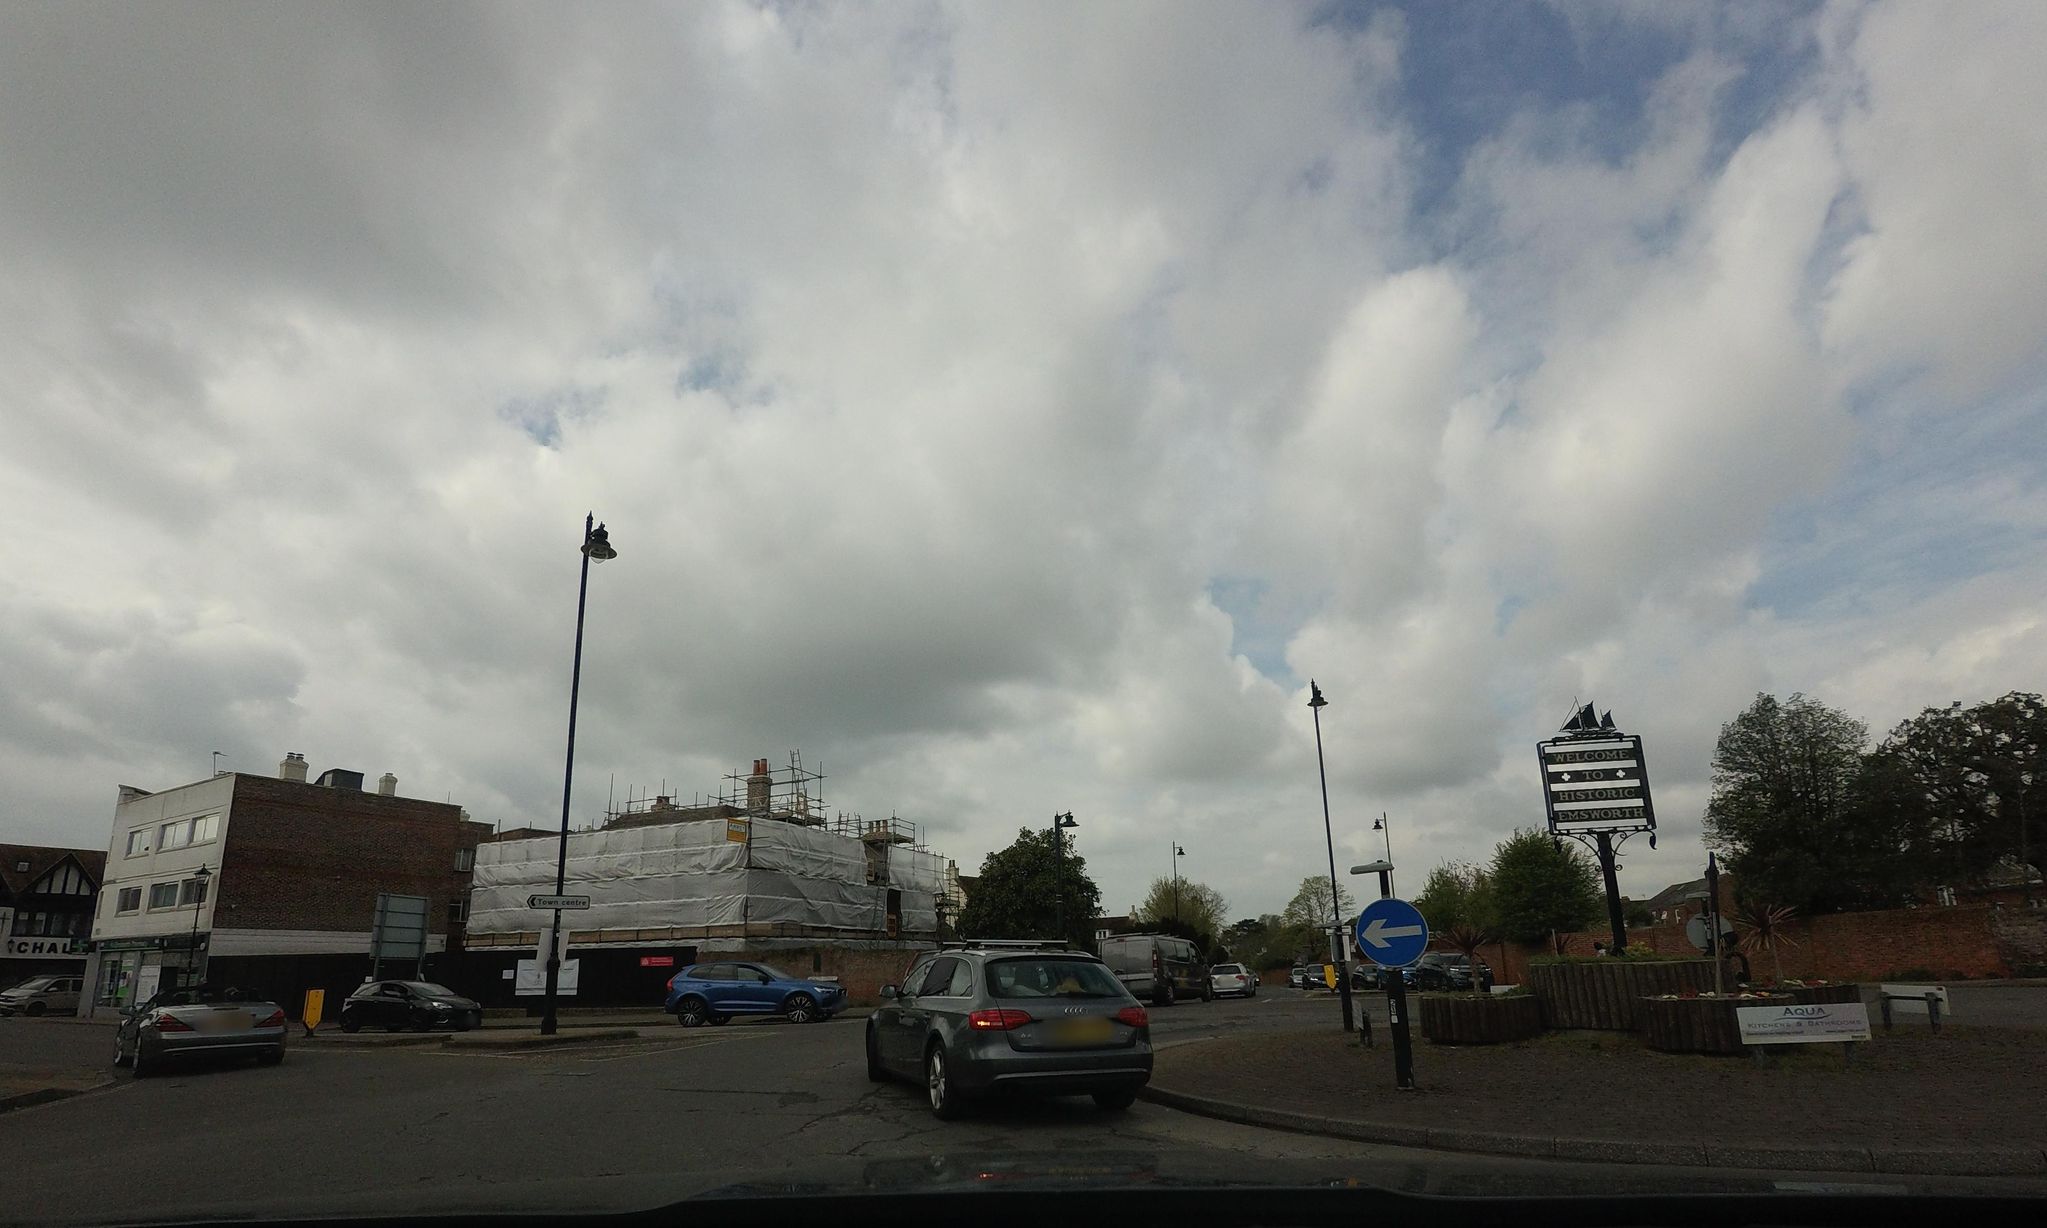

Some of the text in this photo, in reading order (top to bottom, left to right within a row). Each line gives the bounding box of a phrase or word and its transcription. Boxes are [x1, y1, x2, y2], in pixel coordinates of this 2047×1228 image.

[1553, 750, 1630, 762] WELCOME
[1582, 770, 1604, 780] TO
[1559, 788, 1635, 801] HISTORIC
[1558, 807, 1645, 821] EMSWORTH
